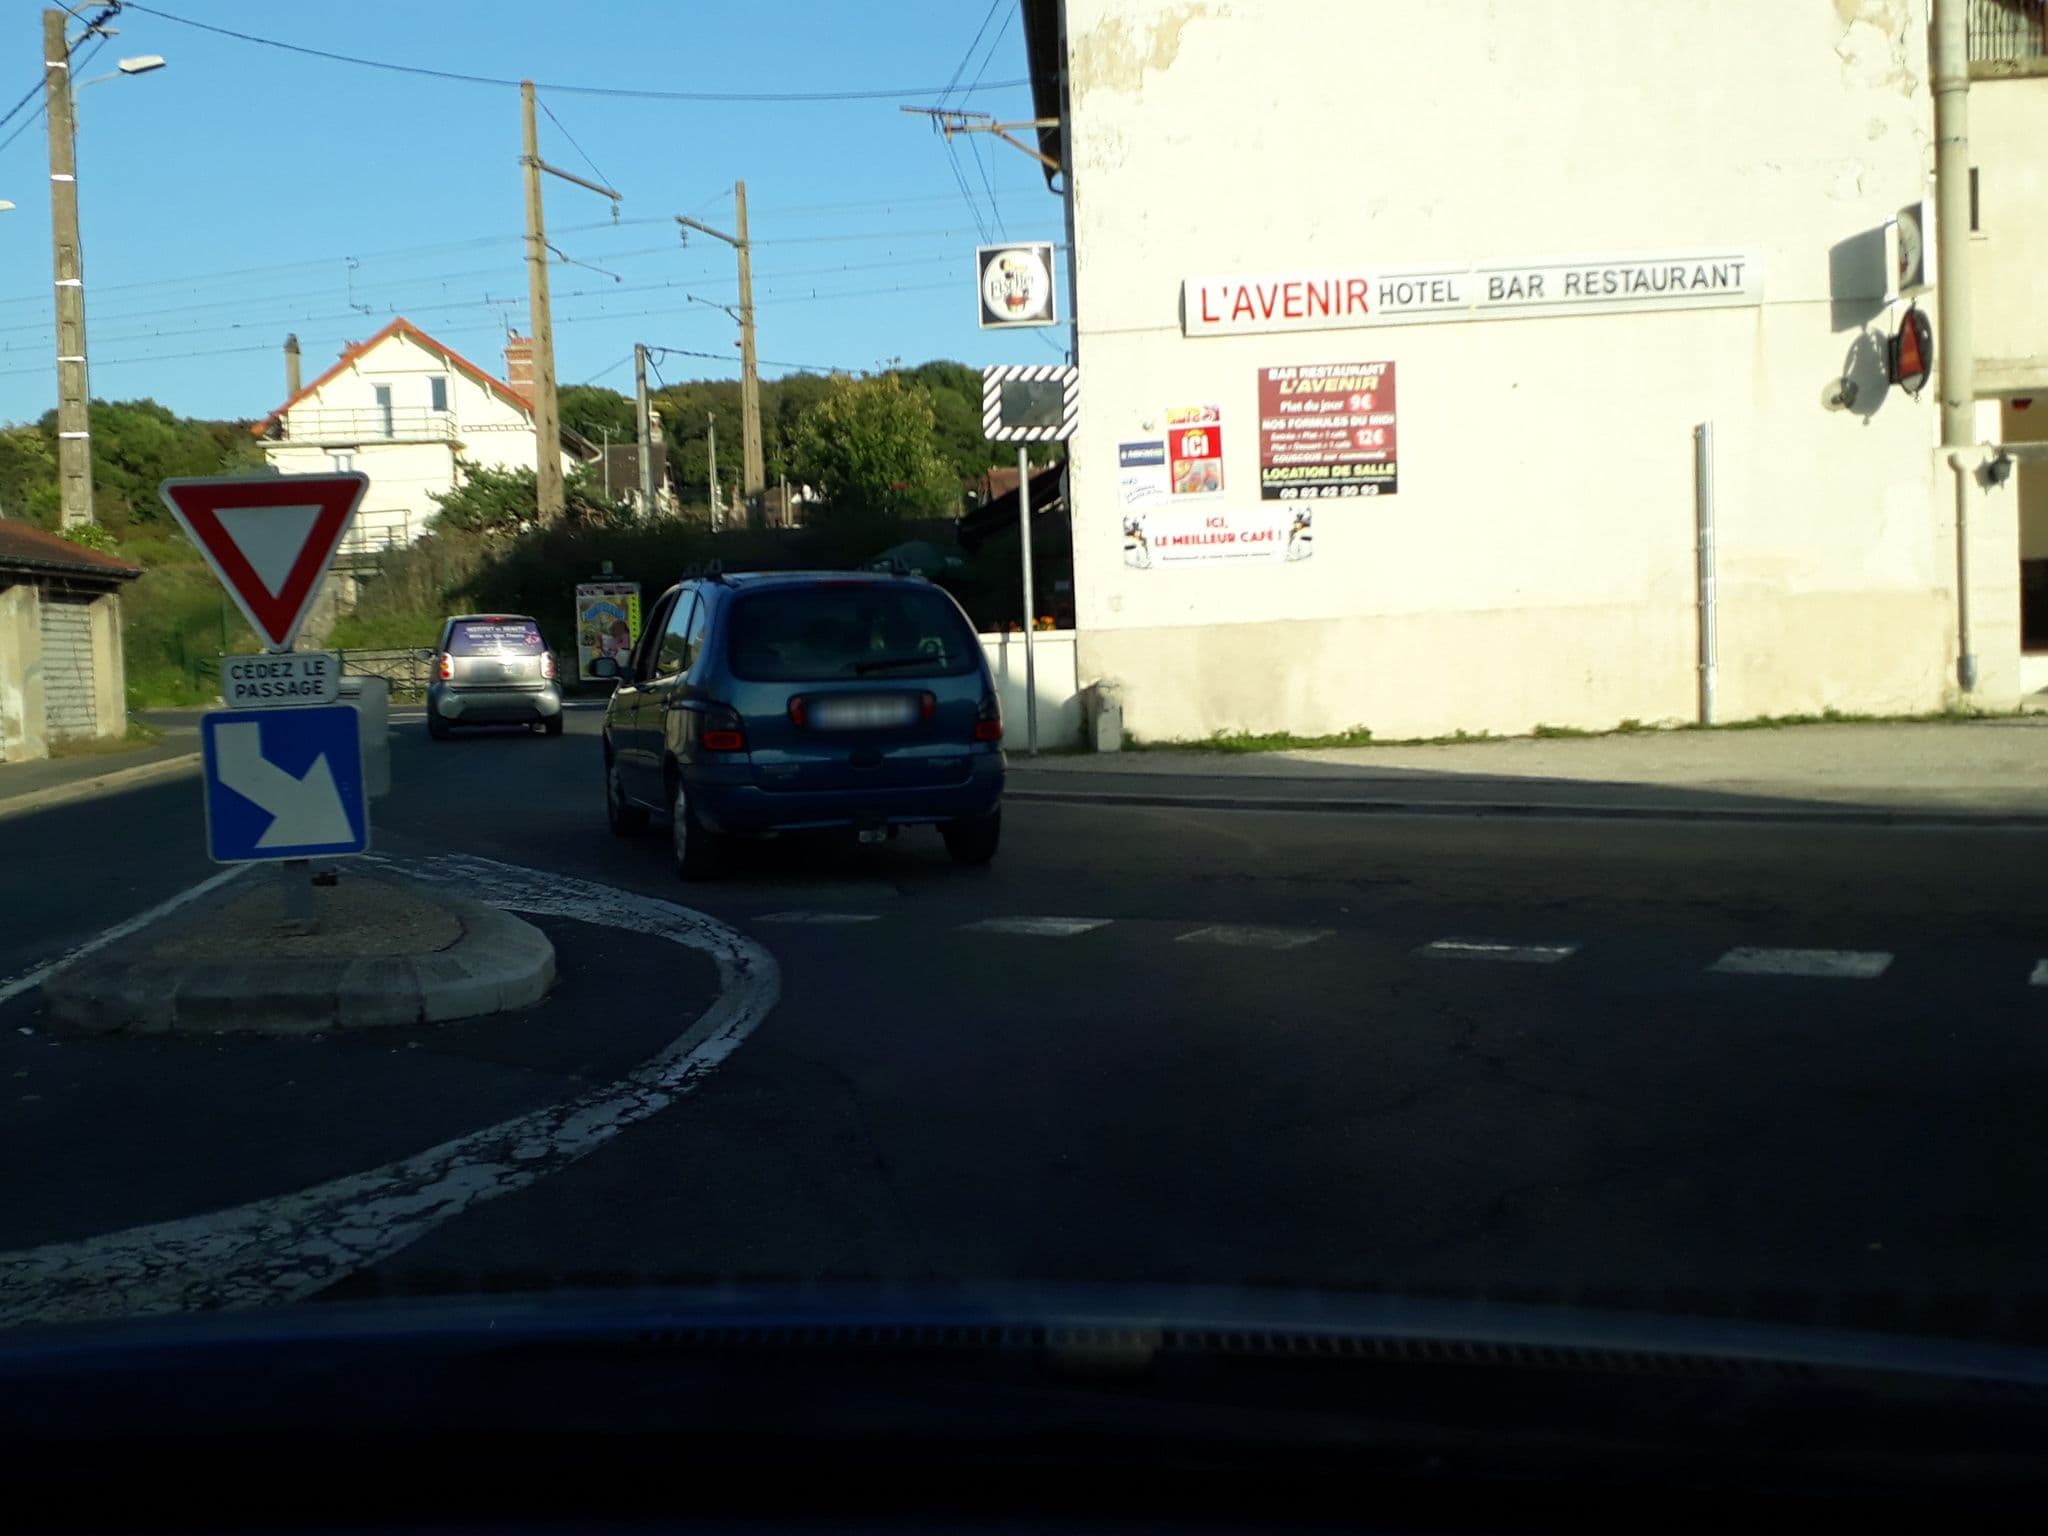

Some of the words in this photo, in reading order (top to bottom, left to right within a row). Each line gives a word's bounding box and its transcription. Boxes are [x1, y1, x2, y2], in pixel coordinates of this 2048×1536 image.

[1201, 279, 1369, 322] L'AVENIR
[1378, 280, 1460, 306] HOTEL
[1487, 273, 1546, 301] BAR
[1563, 263, 1746, 297] RESTAURANT
[1268, 368, 1297, 381] BAR
[1299, 364, 1387, 379] RESTAURANT
[1279, 375, 1378, 394] L'AVENIR
[1304, 398, 1320, 411] du
[1319, 398, 1345, 414] jour
[1262, 418, 1286, 430] NOS
[1287, 415, 1349, 429] FORMULES
[1349, 415, 1368, 427] DU
[1181, 434, 1209, 457] ICI
[1262, 466, 1330, 480] LOCATION
[1331, 464, 1351, 477] DE
[1353, 462, 1396, 476] SALLE
[1154, 535, 1168, 547] LE
[1172, 532, 1236, 545] MEILLEUR
[1239, 527, 1274, 543] CAFÉ
[304, 661, 326, 676] LE
[235, 680, 324, 698] PASSAGE
